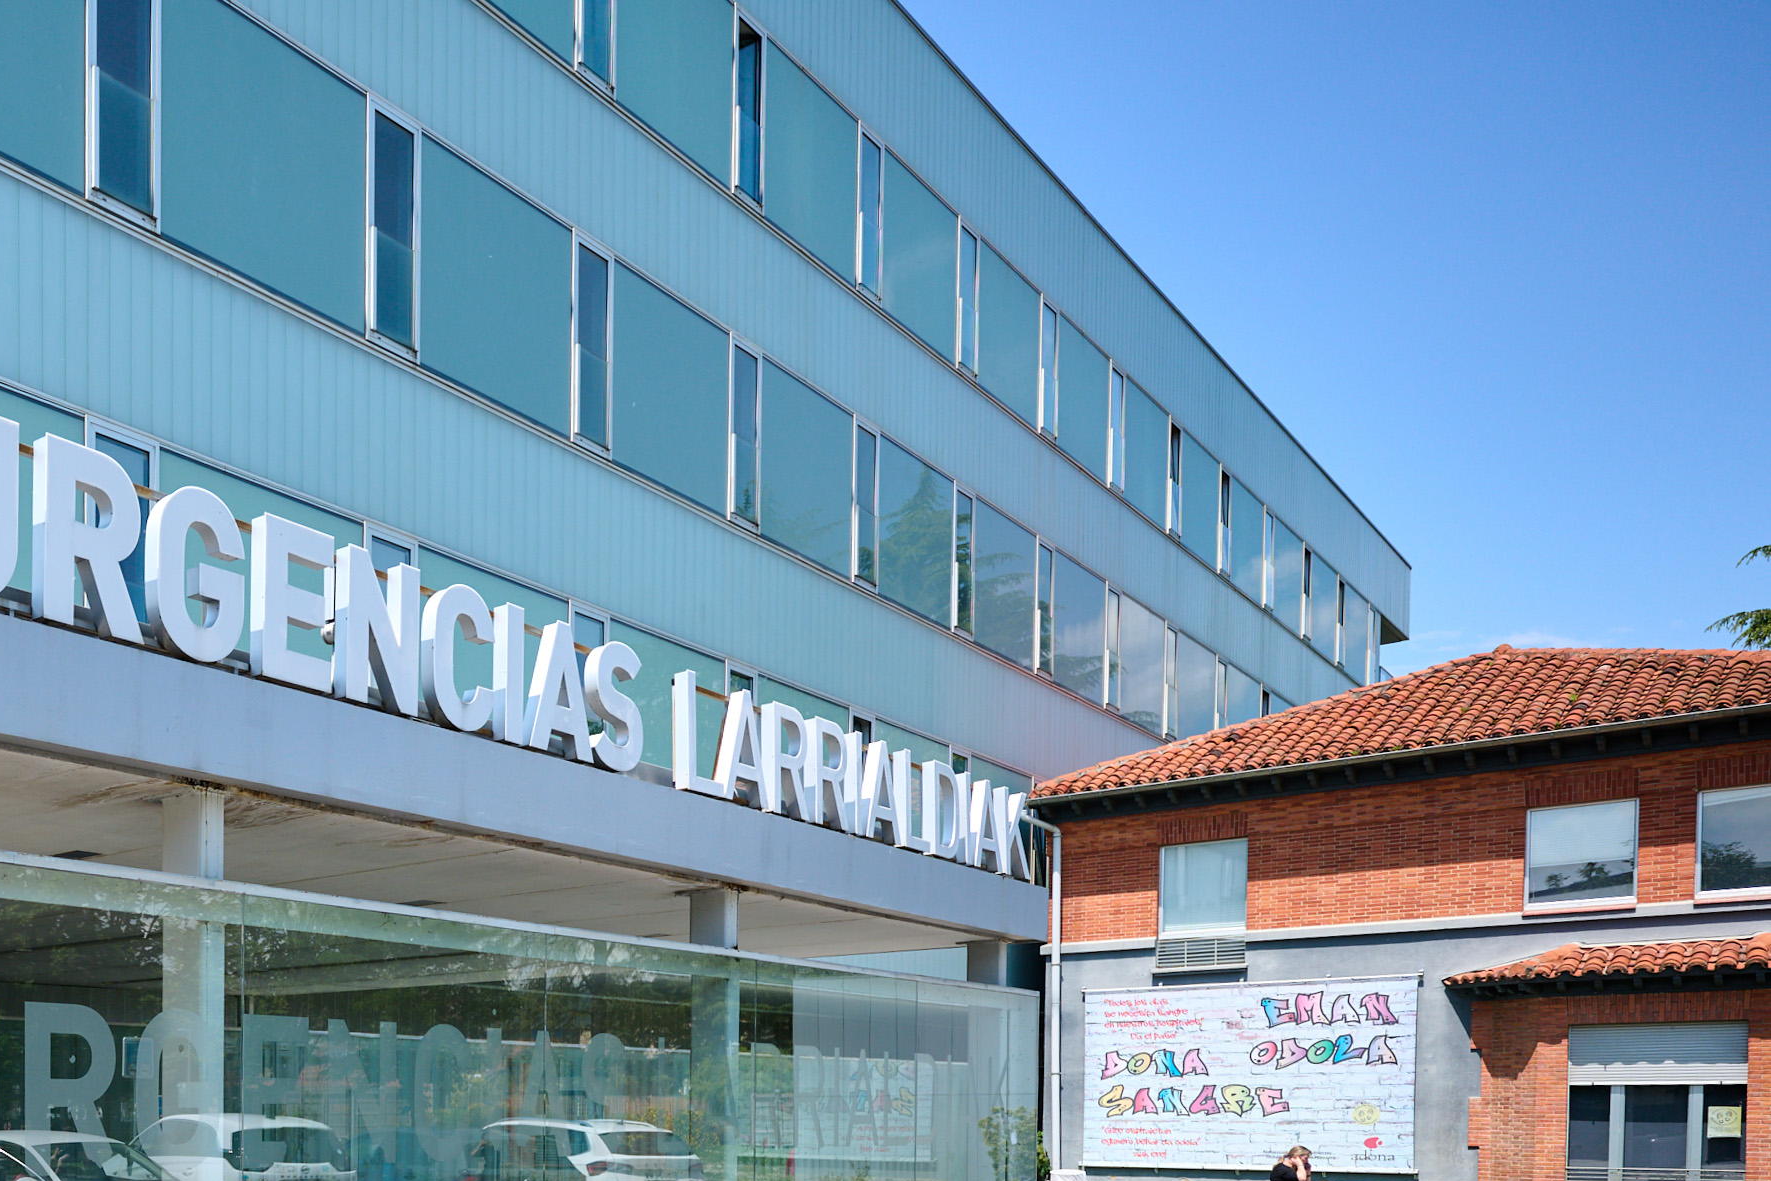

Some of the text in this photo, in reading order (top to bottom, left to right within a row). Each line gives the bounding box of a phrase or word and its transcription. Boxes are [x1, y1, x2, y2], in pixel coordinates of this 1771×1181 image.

[674, 669, 1030, 880] LARRIALDIAK
[1261, 991, 1399, 1028] EMAN
[1101, 1049, 1209, 1080] DONA
[1250, 1034, 1398, 1070] ODOLA
[1098, 1084, 1290, 1118] SANGRE
